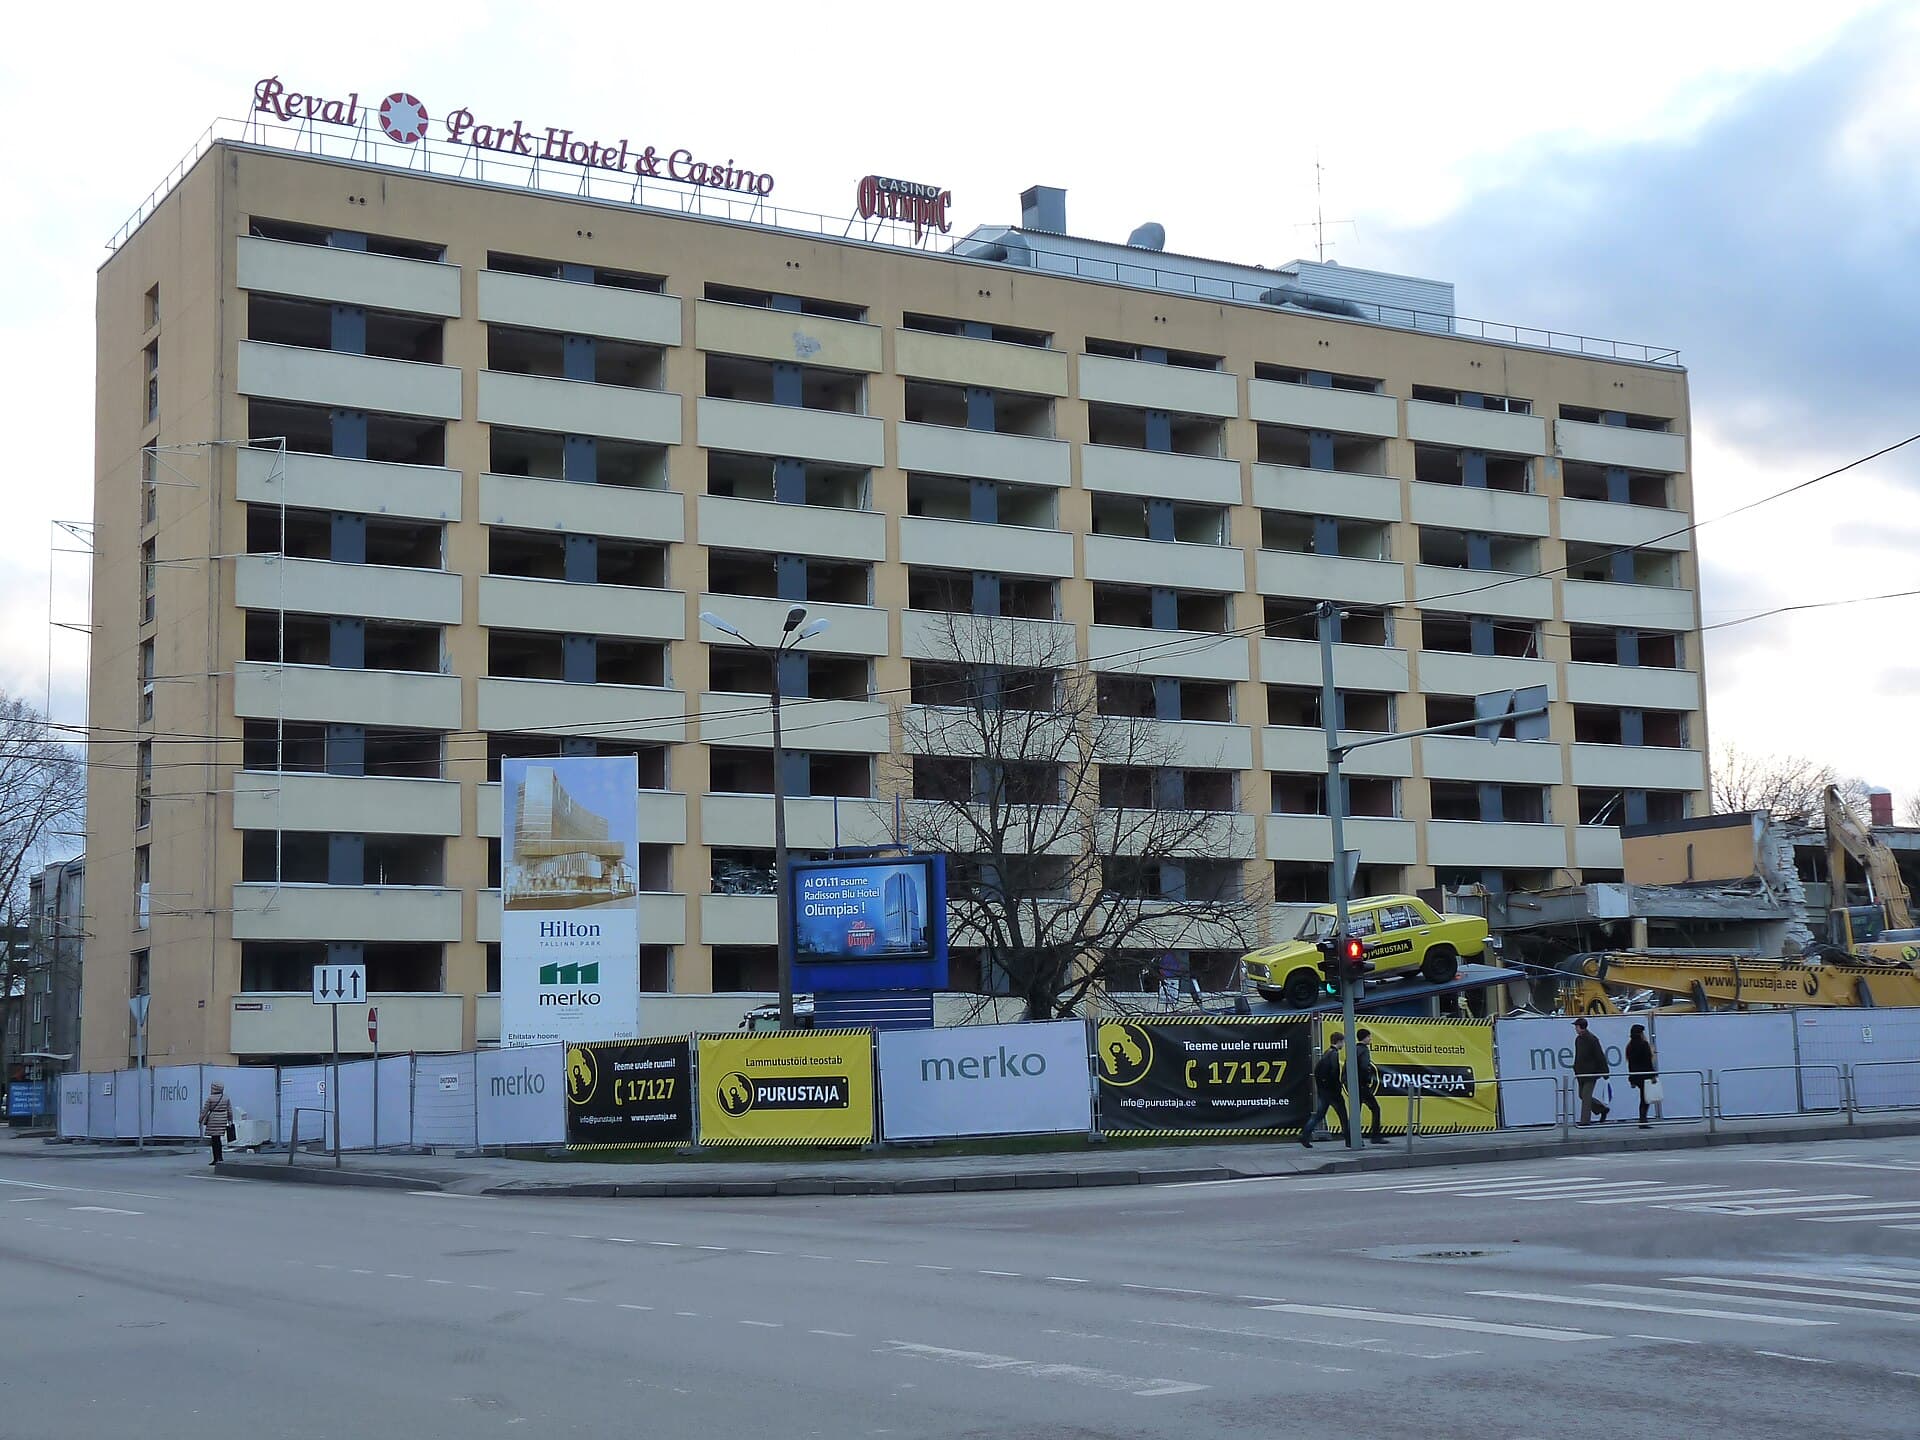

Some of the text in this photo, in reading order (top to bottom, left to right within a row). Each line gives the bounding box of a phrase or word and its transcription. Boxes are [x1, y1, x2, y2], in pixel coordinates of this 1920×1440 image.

[254, 75, 774, 194] Reval Park Hotel & Casino
[878, 177, 937, 198] CASINO
[815, 877, 839, 887] 01.11
[840, 877, 869, 886] asume
[804, 887, 880, 901] Radisson Blu Hotel
[805, 902, 859, 918] Olümpias
[540, 920, 601, 938] Hilton
[540, 989, 601, 1006] merko
[1183, 1039, 1288, 1051] Teeme uuele ruumi!
[1434, 1044, 1465, 1055] teostab
[614, 1058, 676, 1072] Teeme uuele ruumi!
[745, 1055, 843, 1067] Lammutustöid teostab
[921, 1046, 1047, 1082] merko
[1530, 1045, 1622, 1071] meo
[1208, 1060, 1288, 1085] 17127
[160, 1080, 188, 1102] merko
[491, 1067, 545, 1097] merko
[628, 1078, 675, 1101] 17127
[1382, 1073, 1466, 1092] PURUSTAJA
[757, 1085, 840, 1104] PURUSTAJA
[1120, 1097, 1290, 1109] info@purustaja.ee www.purustaja.ee
